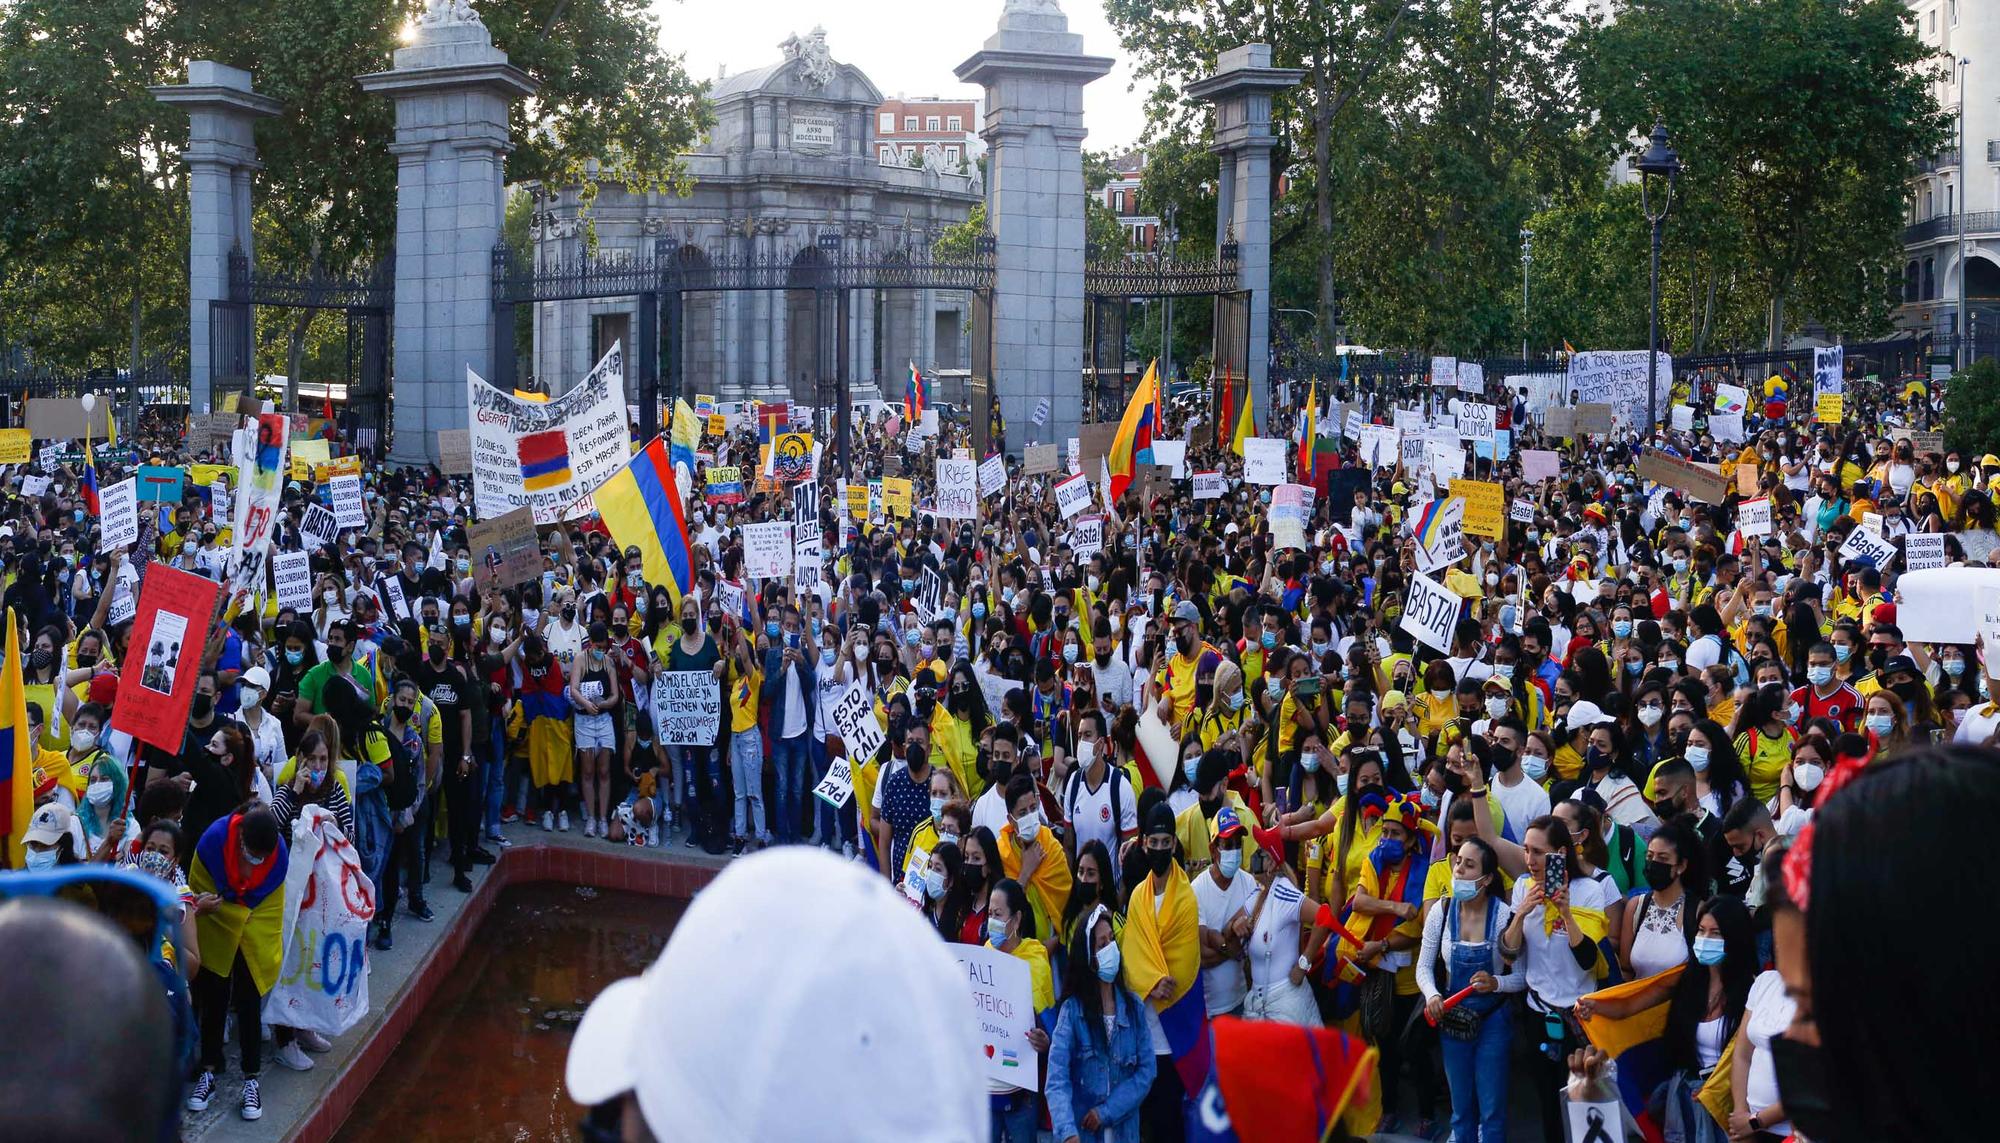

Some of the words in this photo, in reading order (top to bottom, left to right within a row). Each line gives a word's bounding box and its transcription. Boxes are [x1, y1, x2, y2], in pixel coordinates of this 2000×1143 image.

[473, 384, 493, 408] NO
[1464, 403, 1488, 420] SOS
[1458, 420, 1493, 438] COLOMBIA
[477, 436, 496, 451] DUQUE
[712, 467, 739, 483] FUERZA
[939, 463, 972, 485] URIBE
[332, 481, 338, 490] EL
[337, 479, 359, 490] GOBIERNO
[483, 481, 504, 494] PUEBLO
[870, 484, 882, 499] PAZ
[333, 490, 360, 502] COLOMBIANO
[508, 492, 557, 507] COLOMBIA
[560, 484, 579, 502] NOS
[795, 482, 818, 525] PAZ
[939, 488, 973, 509] PARACO
[336, 503, 348, 514] ATACA
[348, 502, 353, 511] A
[1512, 502, 1534, 520] Basta!
[301, 506, 339, 544] ¡BASTA!
[796, 523, 819, 542] JUSTA
[1073, 523, 1101, 547] Basta!
[1444, 537, 1456, 550] VAN
[1906, 538, 1913, 547] EL
[1913, 537, 1942, 547] GOBIERNO
[1847, 529, 1894, 566] Basta!
[1907, 549, 1942, 559] COLOMBIANO
[274, 562, 279, 571] EL
[279, 557, 306, 570] GOBIERNO
[1909, 561, 1926, 571] ATACA
[1926, 562, 1931, 570] A
[1931, 560, 1943, 570] SUS
[275, 570, 309, 585] COLOMBIANO
[797, 566, 818, 588] JUSTA
[278, 586, 294, 599] ATACA
[299, 582, 309, 595] SUS
[921, 568, 939, 615] PAZ
[109, 599, 135, 621] Basta!
[1407, 580, 1458, 648] BASTA!
[656, 672, 681, 689] SOMOS
[681, 674, 691, 687] EL
[691, 671, 718, 688] GRITO
[657, 689, 667, 700] DE
[670, 688, 685, 700] LOS
[685, 687, 700, 699] QUE
[702, 687, 712, 700] YA
[657, 700, 667, 712] NO
[667, 700, 698, 713] TIENEN
[700, 701, 720, 715] VOZ!
[832, 688, 861, 726] ESTO
[840, 721, 853, 738] ES
[851, 700, 871, 728] POR
[852, 726, 866, 744] TI
[853, 731, 880, 766] CALI
[818, 780, 846, 803] PAZ
[956, 959, 995, 987] ALI
[972, 991, 1015, 1019] STENCIA
[980, 1021, 1010, 1039] OLOMBIA
